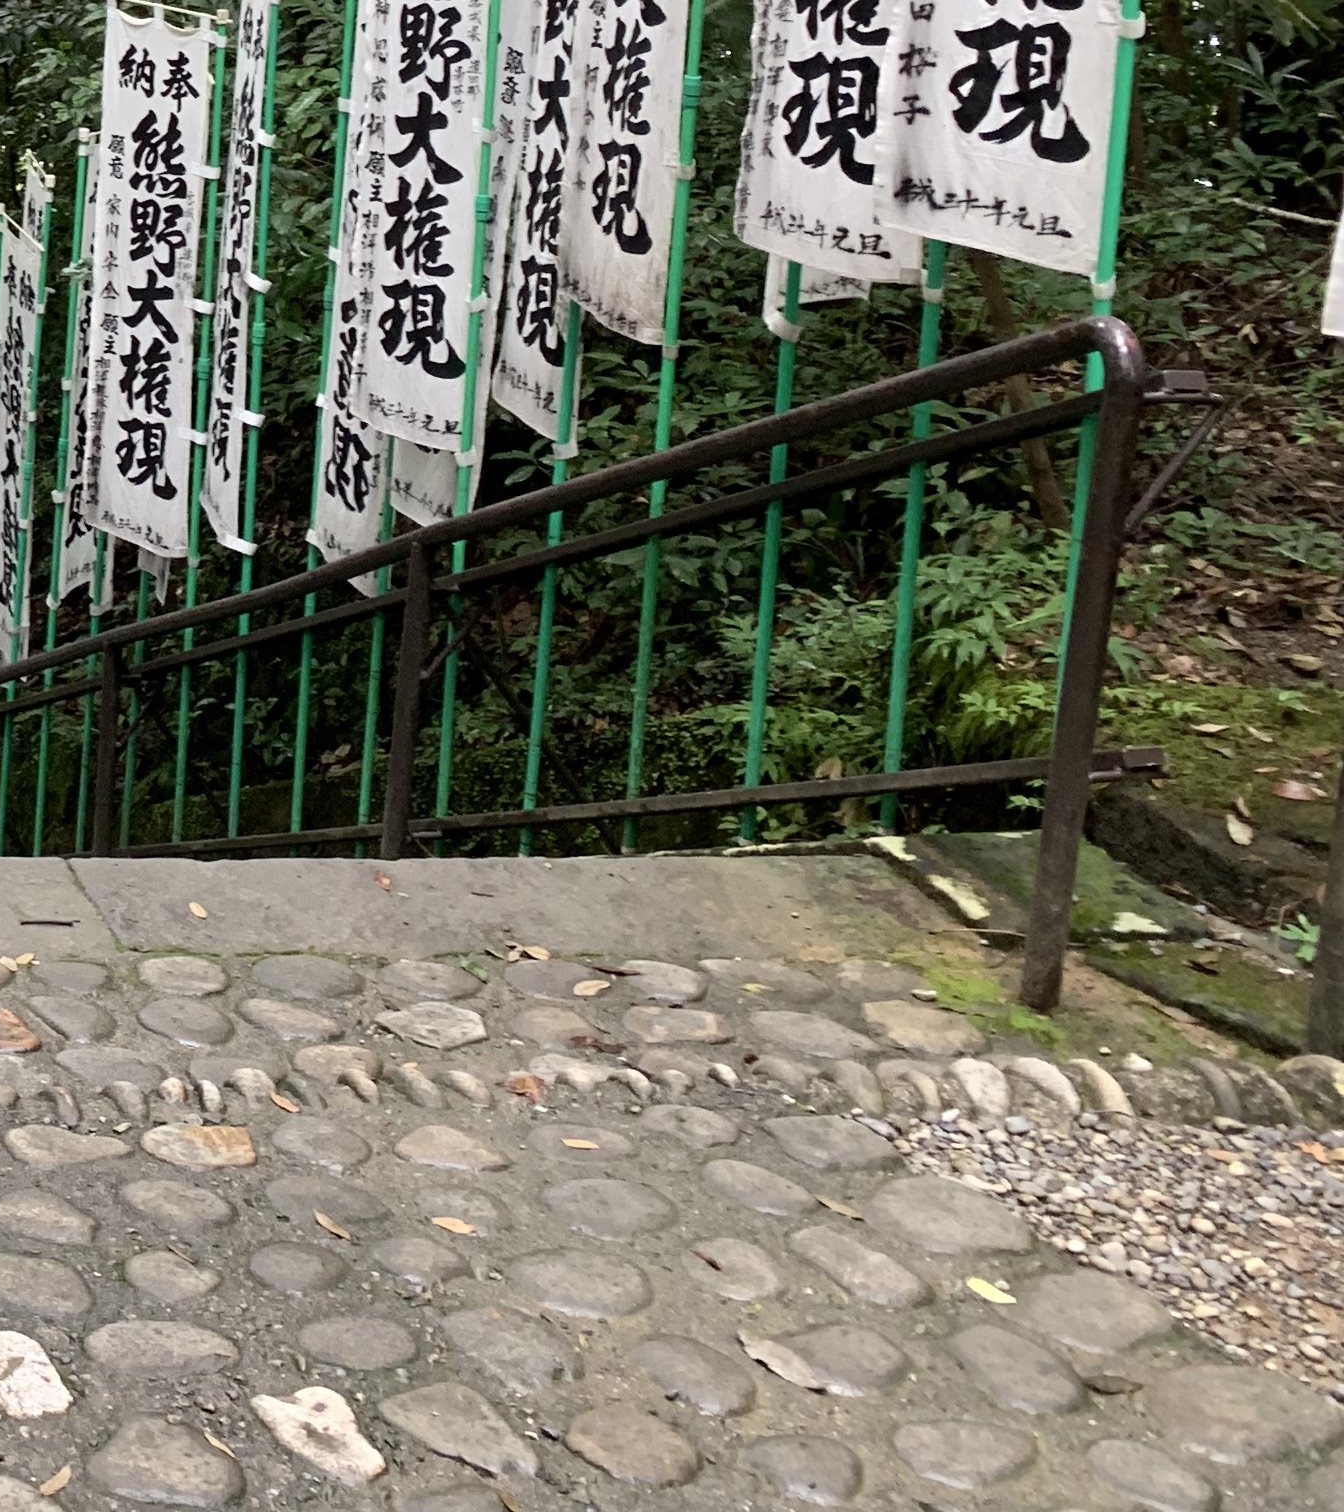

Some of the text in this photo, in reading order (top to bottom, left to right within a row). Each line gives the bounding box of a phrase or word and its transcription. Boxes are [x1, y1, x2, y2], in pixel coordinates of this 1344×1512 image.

[119, 44, 200, 114] 奉納
[115, 110, 188, 500] 熊野大権現
